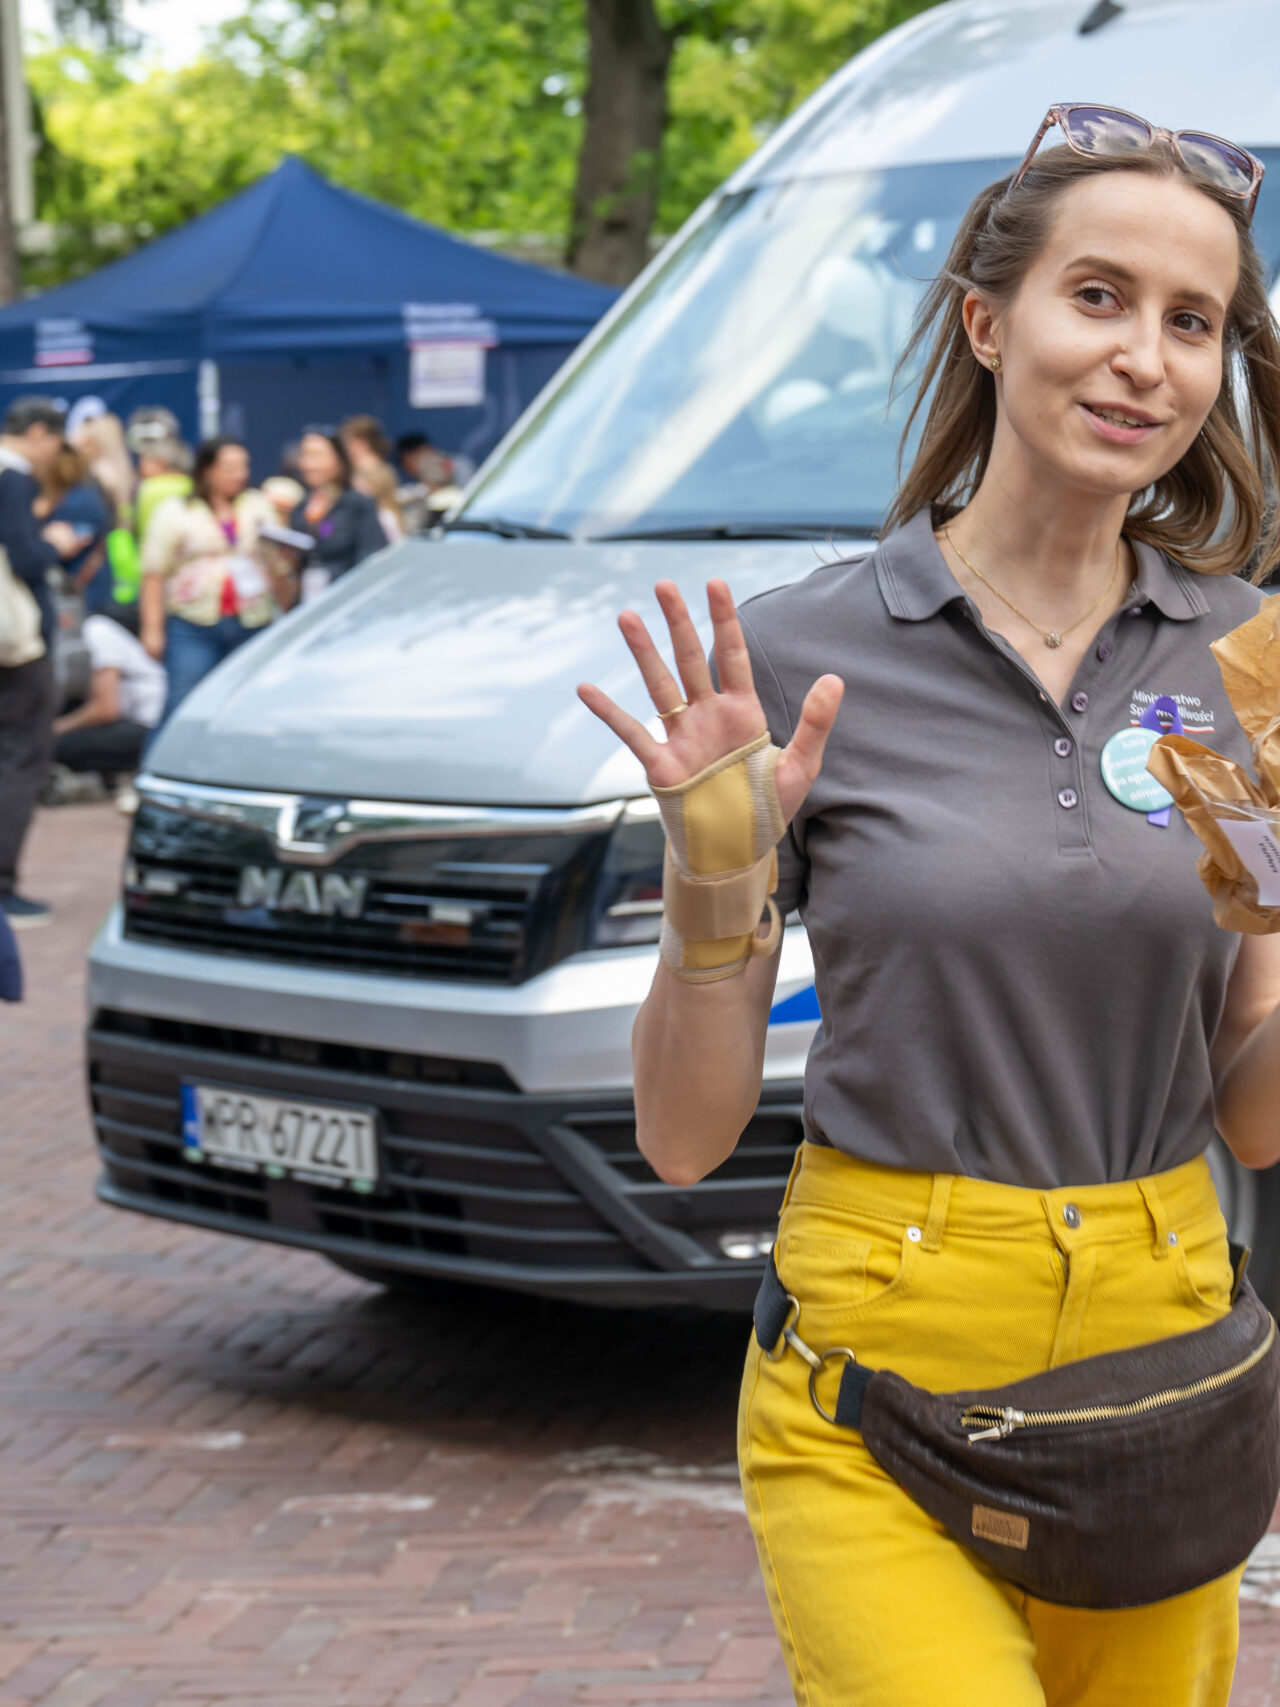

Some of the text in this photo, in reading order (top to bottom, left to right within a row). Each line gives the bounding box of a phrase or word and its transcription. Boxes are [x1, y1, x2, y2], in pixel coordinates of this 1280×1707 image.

[239, 865, 367, 919] MAN
[203, 1097, 367, 1171] WPR 6722T
